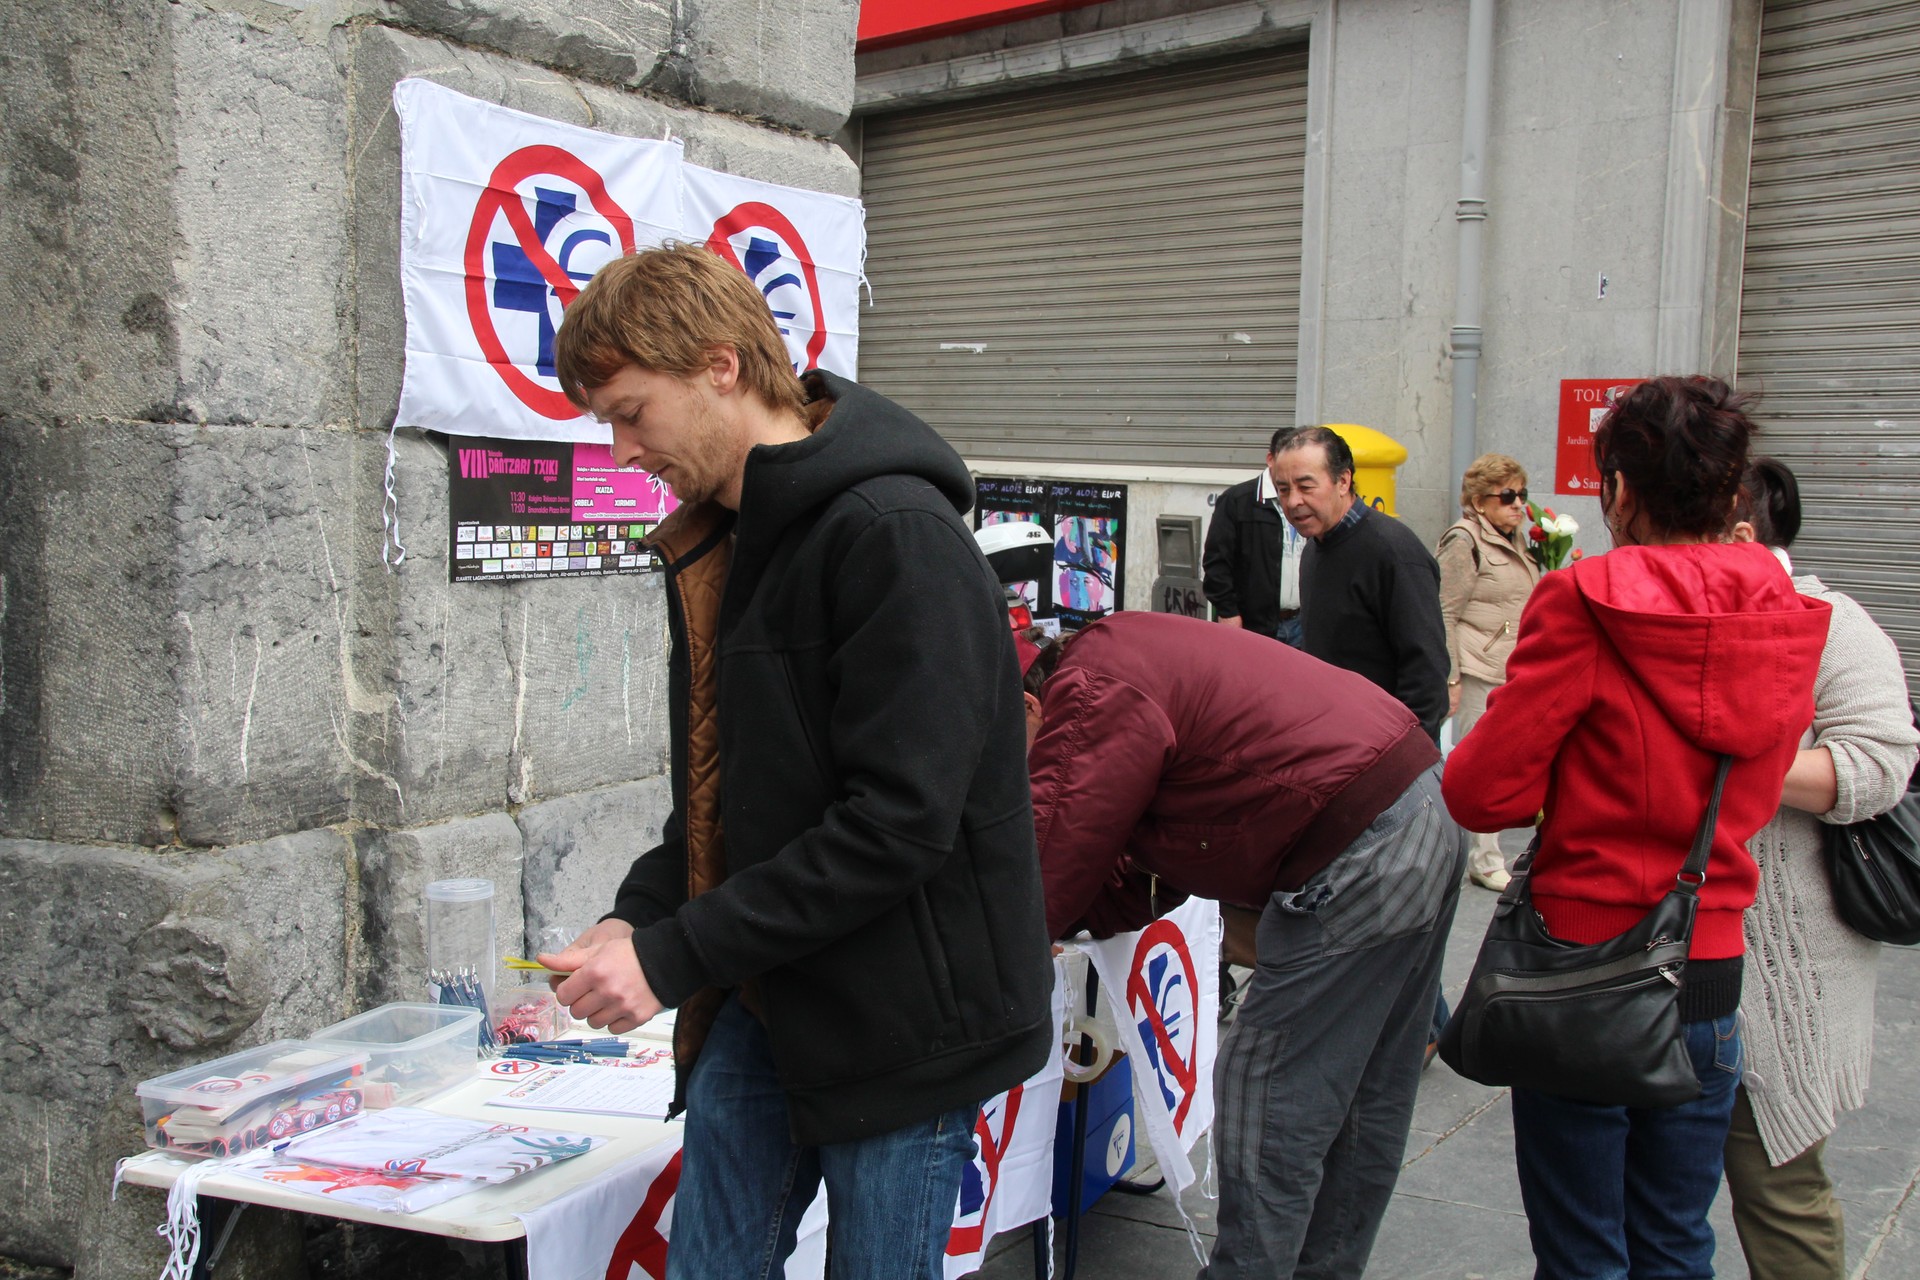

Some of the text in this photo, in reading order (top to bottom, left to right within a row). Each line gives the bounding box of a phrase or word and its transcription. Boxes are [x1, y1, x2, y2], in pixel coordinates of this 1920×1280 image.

[533, 459, 559, 475] TXIKI
[510, 491, 526, 502] 11:30
[510, 503, 526, 514] 17:00
